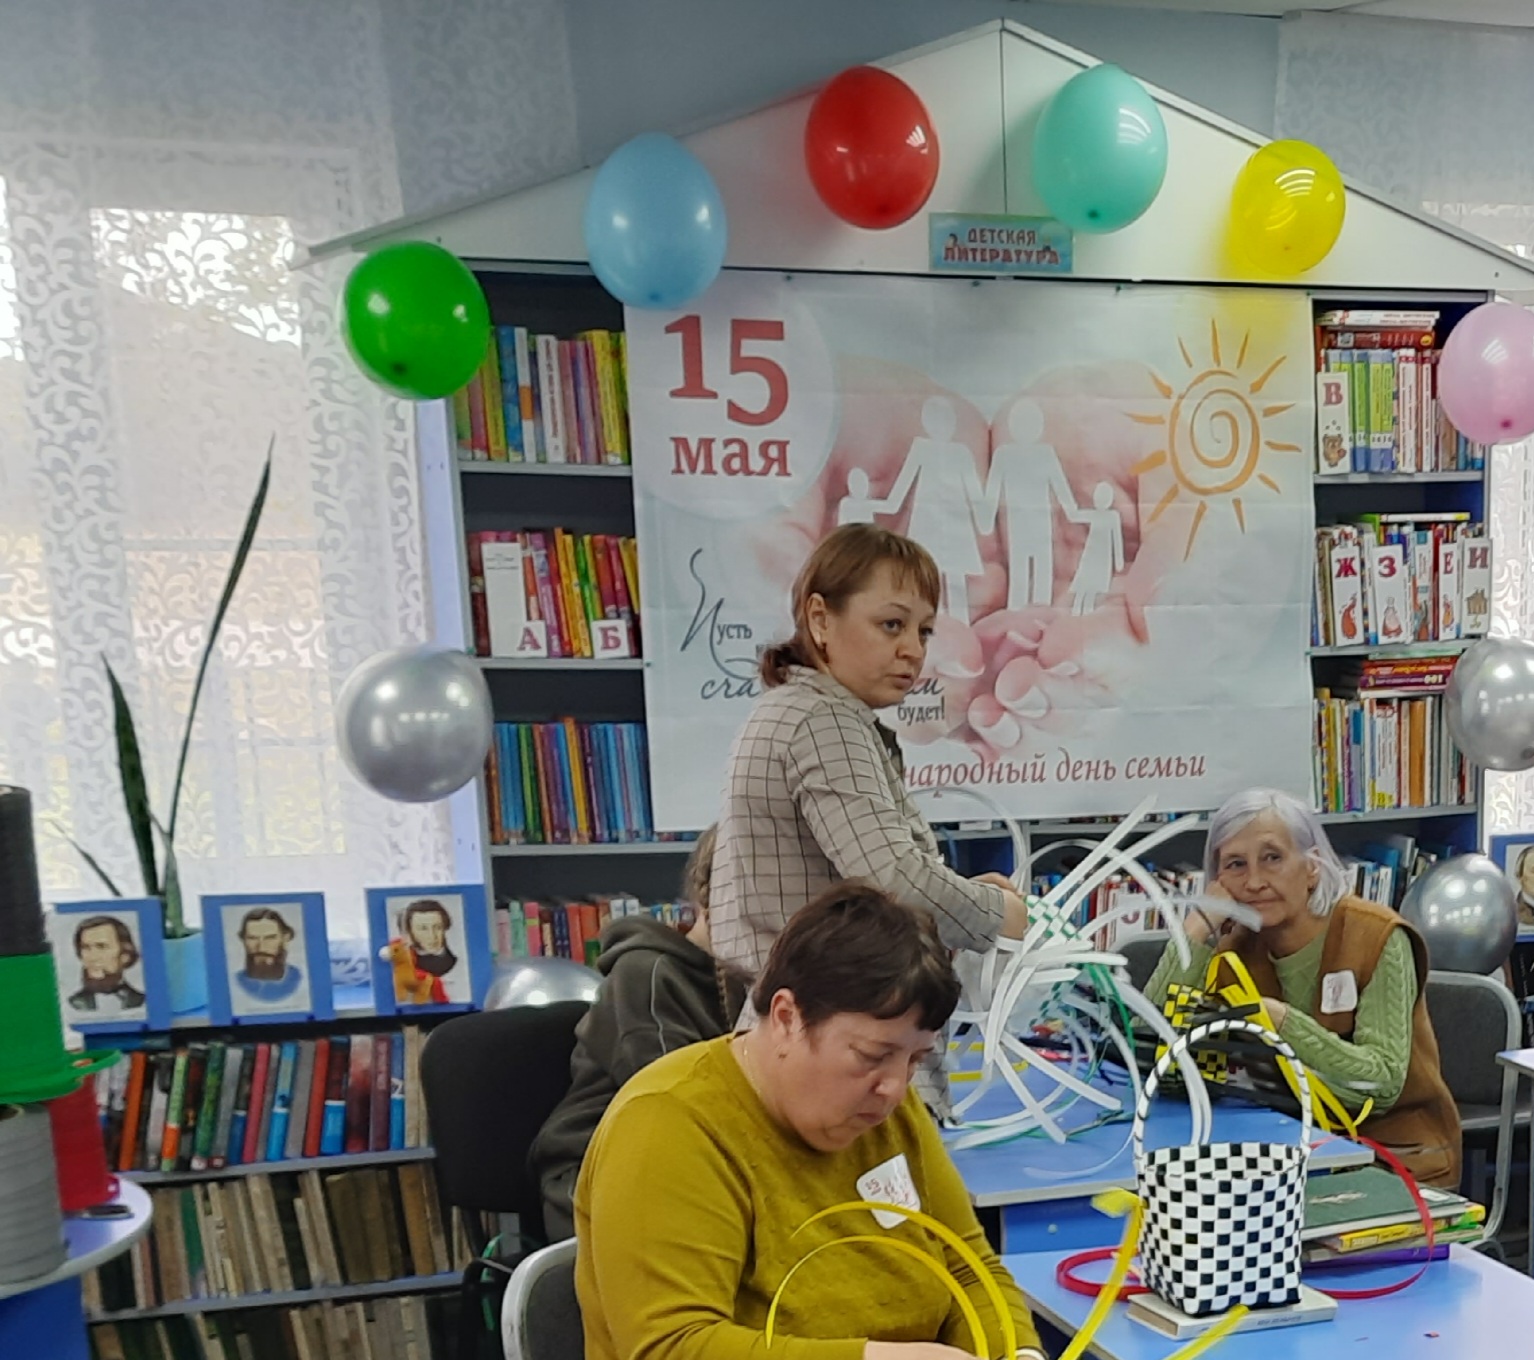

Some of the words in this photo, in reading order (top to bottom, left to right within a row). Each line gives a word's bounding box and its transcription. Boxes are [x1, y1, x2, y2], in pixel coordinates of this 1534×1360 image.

[967, 228, 1036, 246] ДЕТСКАЯ
[943, 246, 1060, 265] ЛИТЕРАТУРА
[664, 314, 790, 427] 15
[1322, 382, 1344, 406] В
[669, 437, 792, 477] мая
[1334, 557, 1358, 578] Ж
[1378, 555, 1398, 578] З
[1443, 551, 1455, 575] Е
[1467, 547, 1489, 569] И
[517, 626, 543, 651] А
[598, 626, 622, 650] Б
[903, 748, 1047, 798] народный
[1055, 747, 1117, 782] день
[1125, 753, 1206, 780] семьи
